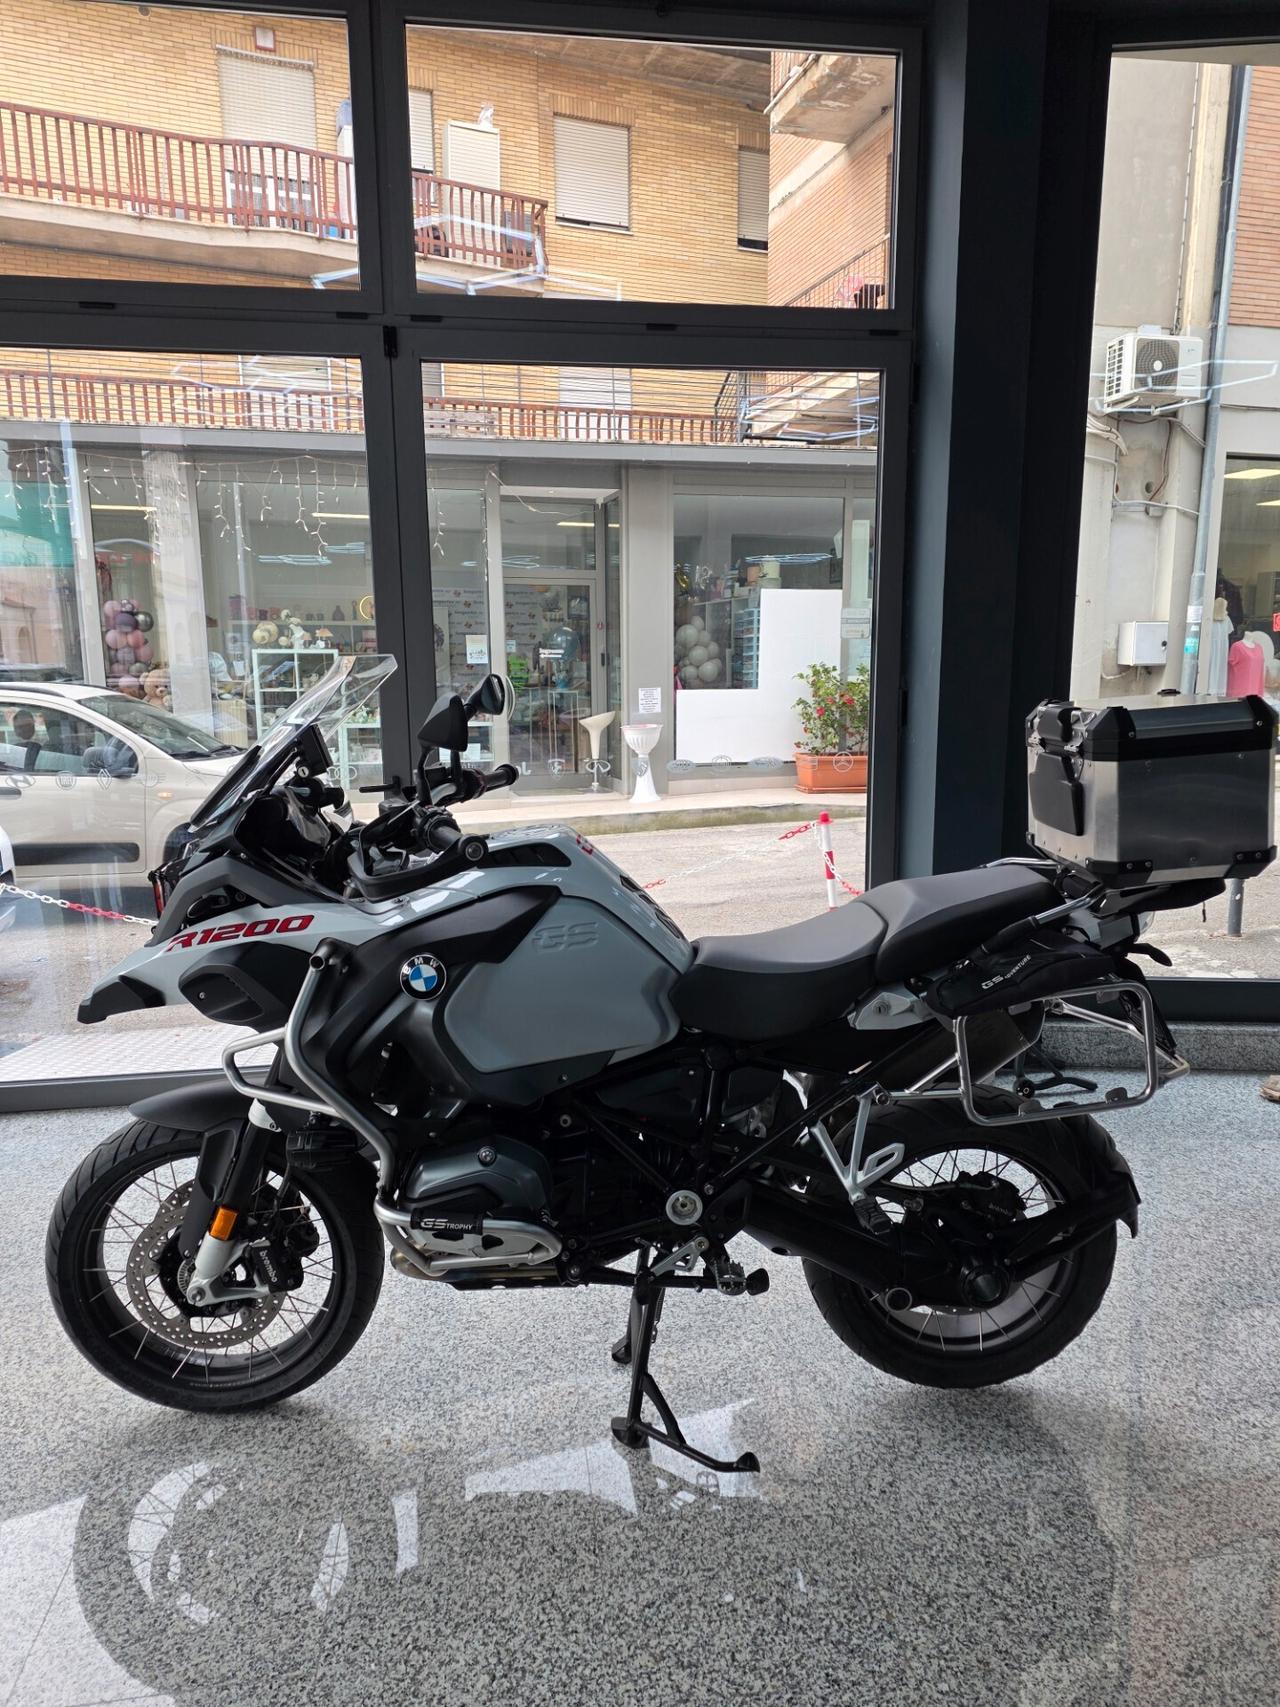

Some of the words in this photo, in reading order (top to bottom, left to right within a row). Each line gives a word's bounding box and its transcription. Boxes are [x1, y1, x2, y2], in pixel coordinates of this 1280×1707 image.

[166, 914, 315, 952] R1200
[532, 921, 599, 952] GS
[981, 974, 1004, 989] GS
[420, 1218, 448, 1229] GS
[446, 1223, 473, 1231] TROPHY
[259, 1249, 278, 1283] brembo
